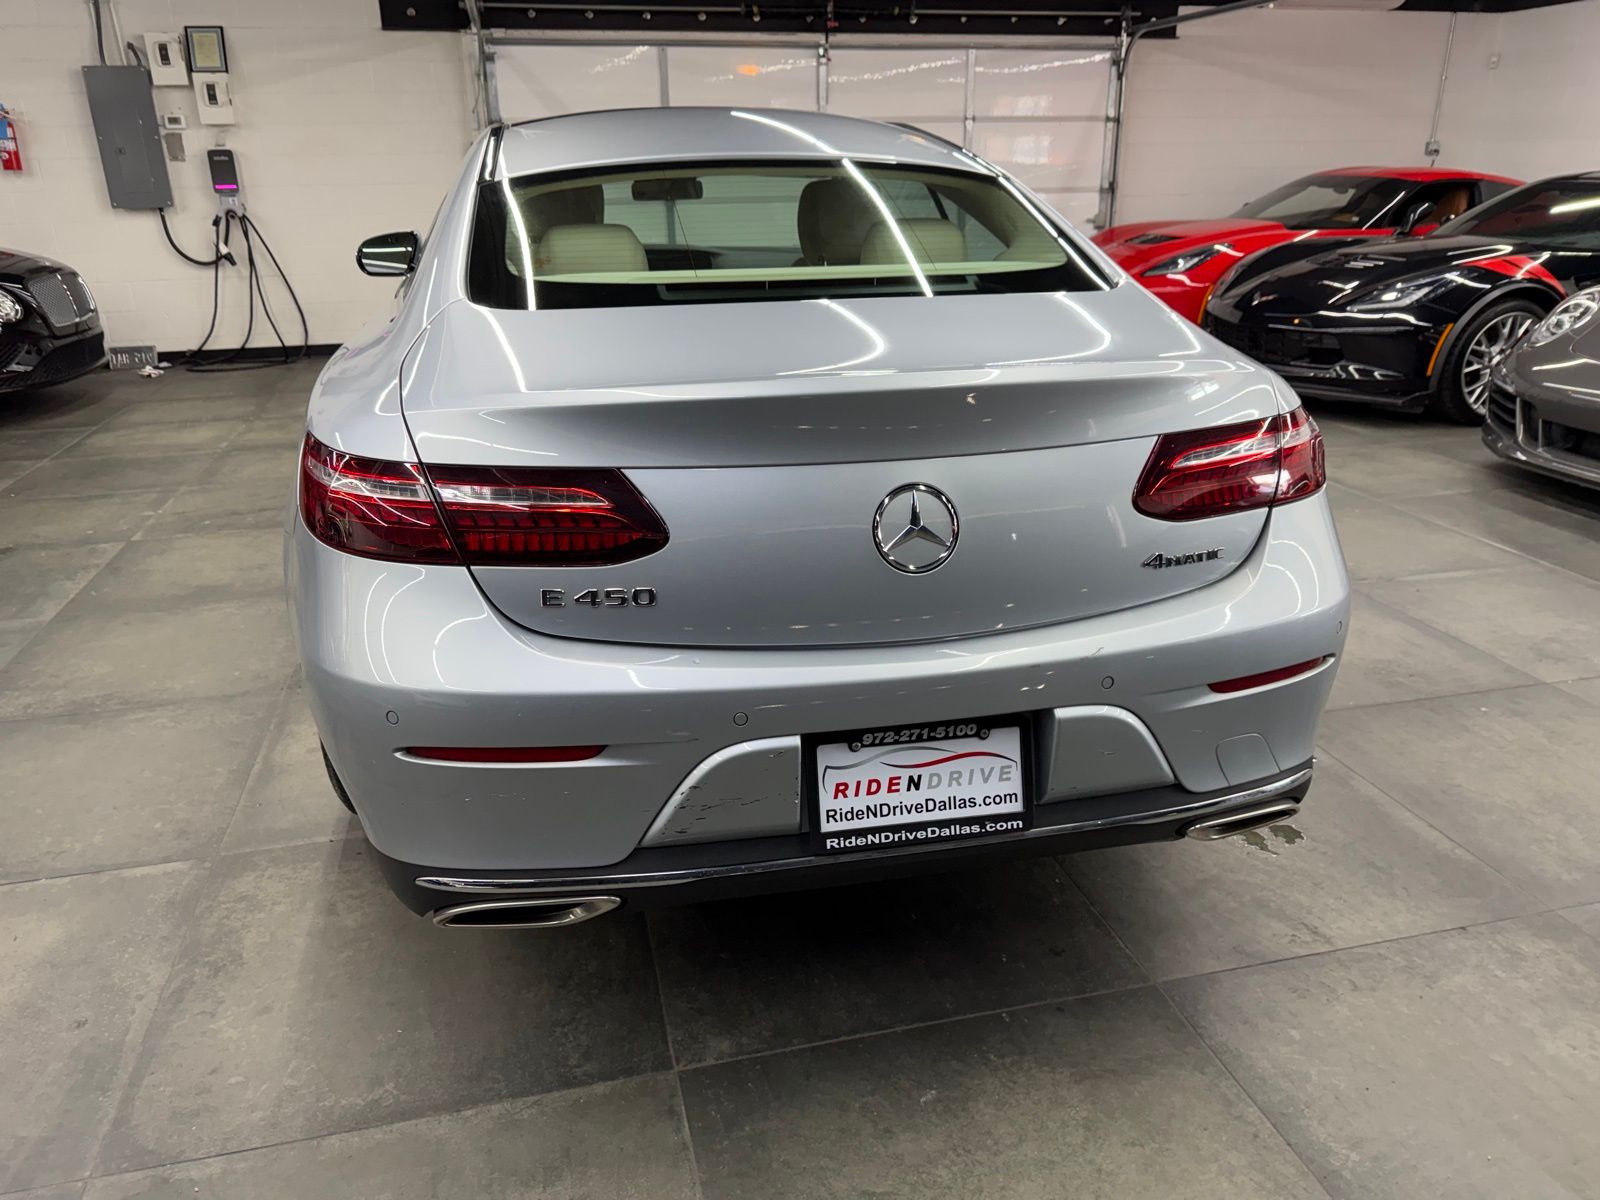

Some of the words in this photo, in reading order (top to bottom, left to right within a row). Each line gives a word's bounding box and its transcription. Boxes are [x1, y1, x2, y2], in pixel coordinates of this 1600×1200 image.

[1141, 547, 1224, 570] 4MATIC
[540, 587, 565, 607] E
[573, 587, 656, 607] 450
[862, 724, 977, 745] 972-271-5100
[825, 792, 1018, 824] RideNDriveDallas.com
[826, 819, 1024, 849] RideNDriveDallas.com
